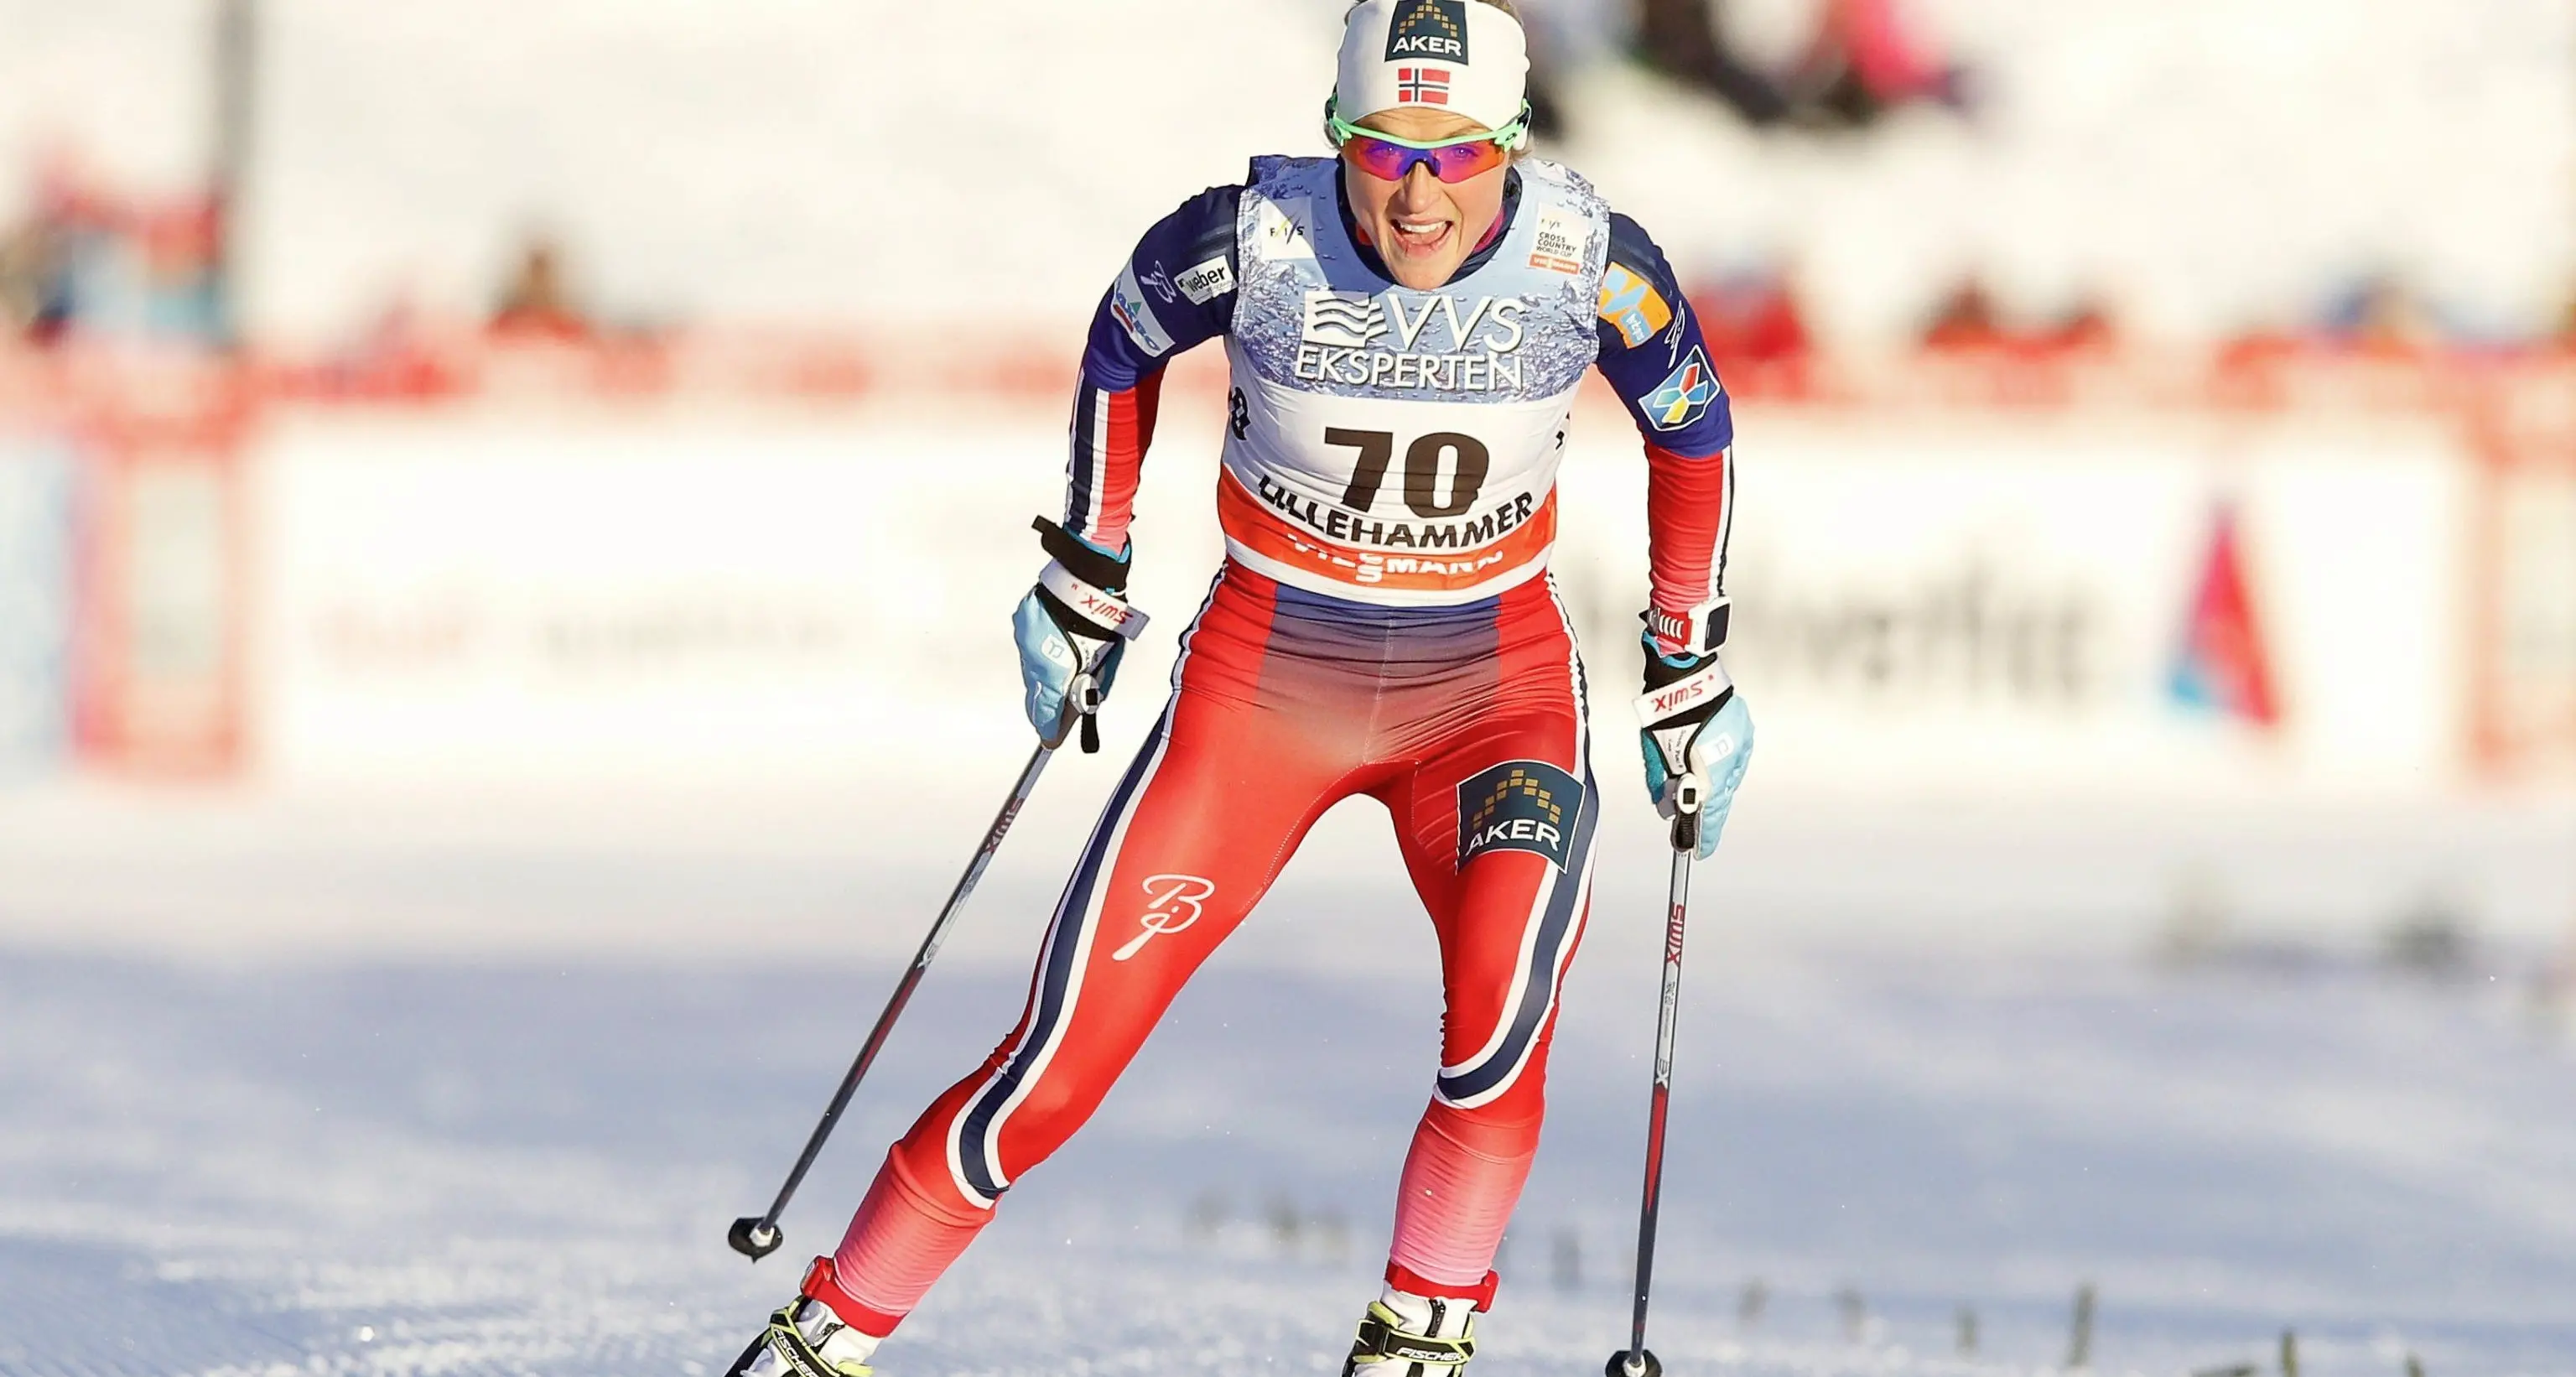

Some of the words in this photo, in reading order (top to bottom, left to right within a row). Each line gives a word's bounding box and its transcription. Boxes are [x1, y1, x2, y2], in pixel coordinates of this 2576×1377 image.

[1392, 35, 1462, 56] AKER
[1537, 239, 1576, 252] COUNTRY
[1539, 231, 1566, 243] CROSS
[1187, 266, 1226, 294] weber
[1387, 293, 1526, 353] VVS
[1295, 345, 1523, 391] EKSPERTEN
[1324, 426, 1490, 518] 70
[1258, 472, 1533, 549] LILLEHAMMER
[1465, 818, 1561, 856] AKER
[1665, 902, 1685, 967] SWIX
